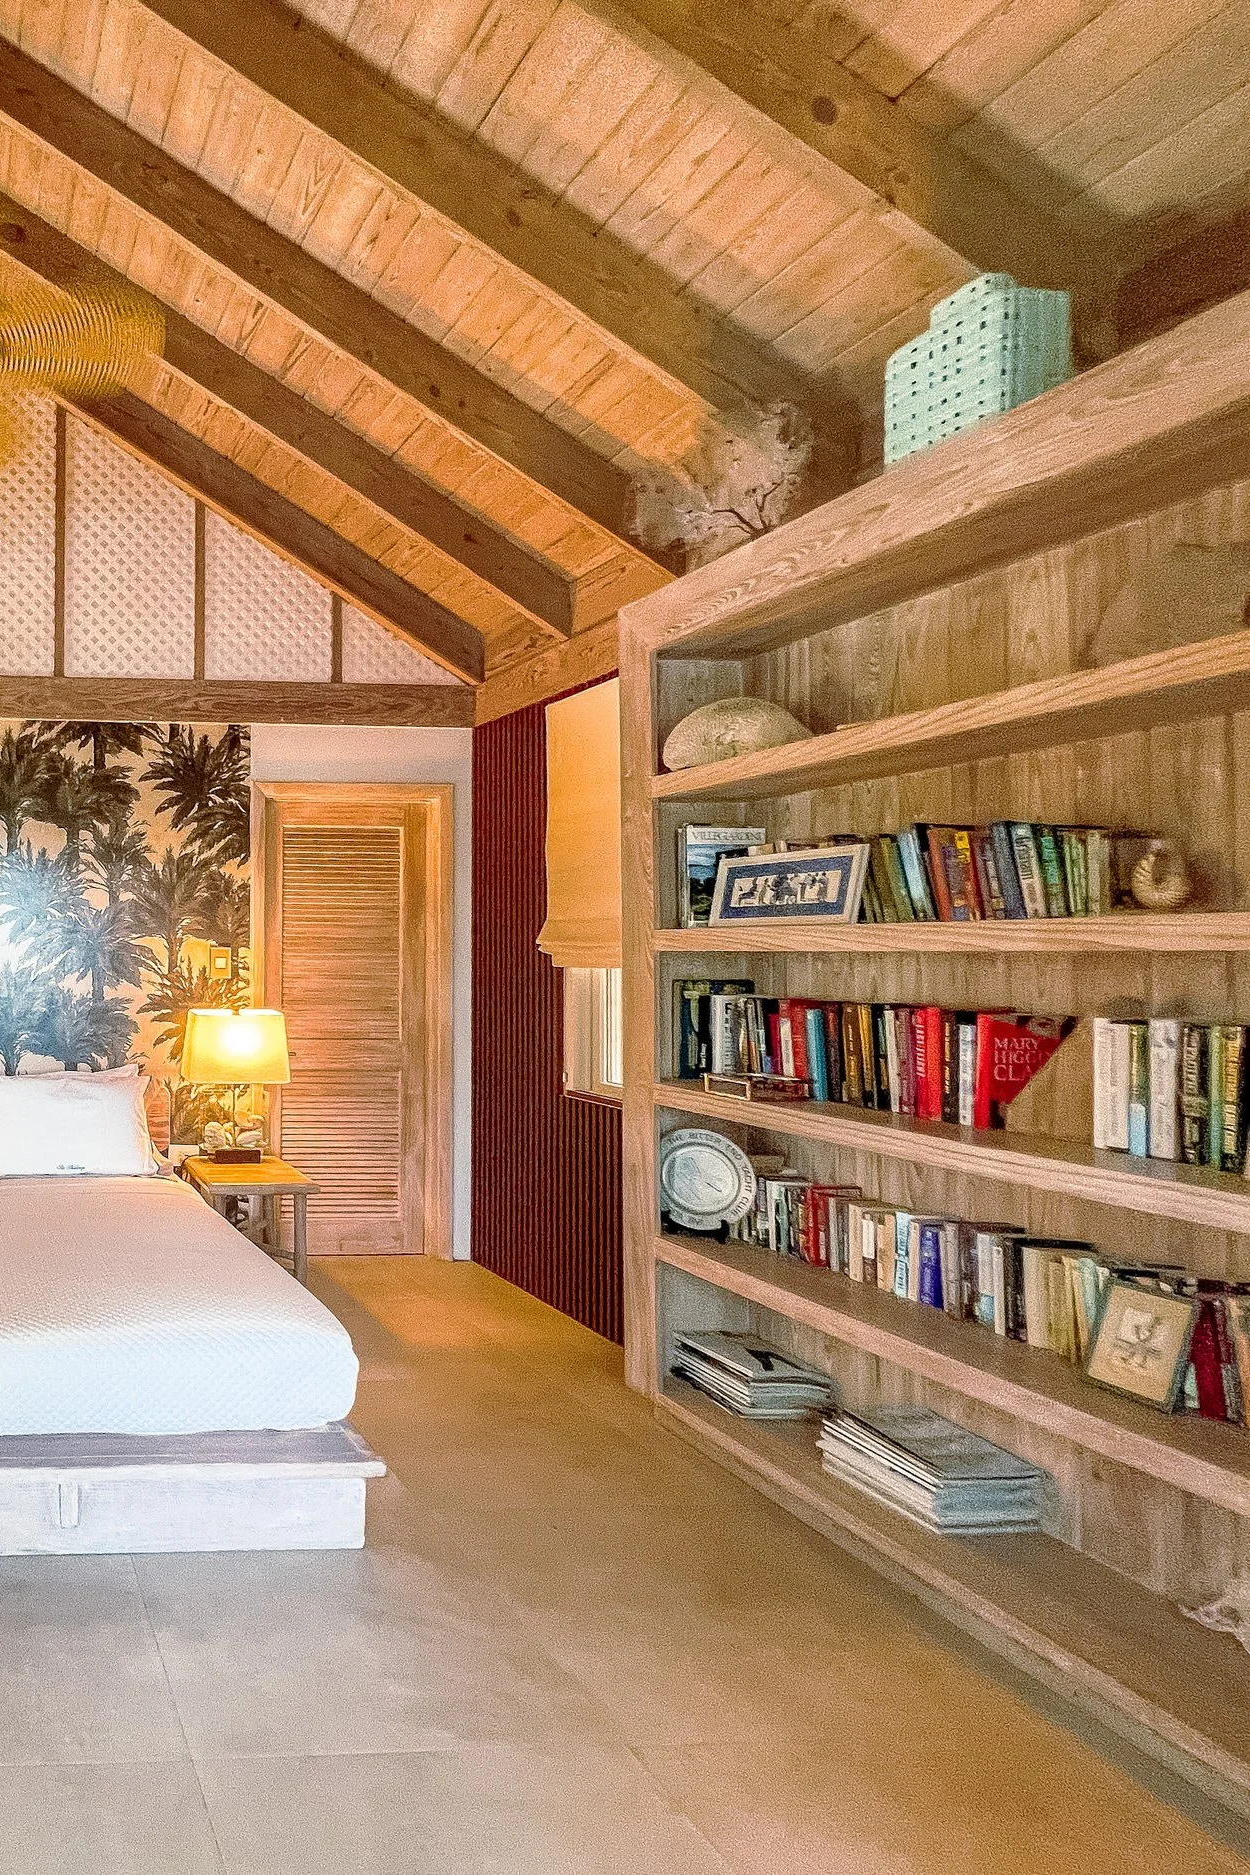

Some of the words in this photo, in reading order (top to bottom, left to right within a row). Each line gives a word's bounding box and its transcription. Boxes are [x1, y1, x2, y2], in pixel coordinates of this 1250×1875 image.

[994, 1036, 1038, 1050] MARY
[689, 1132, 722, 1145] BITTER
[724, 1143, 744, 1161] END
[741, 1163, 753, 1194] YACHT
[730, 1196, 750, 1216] CLUB
